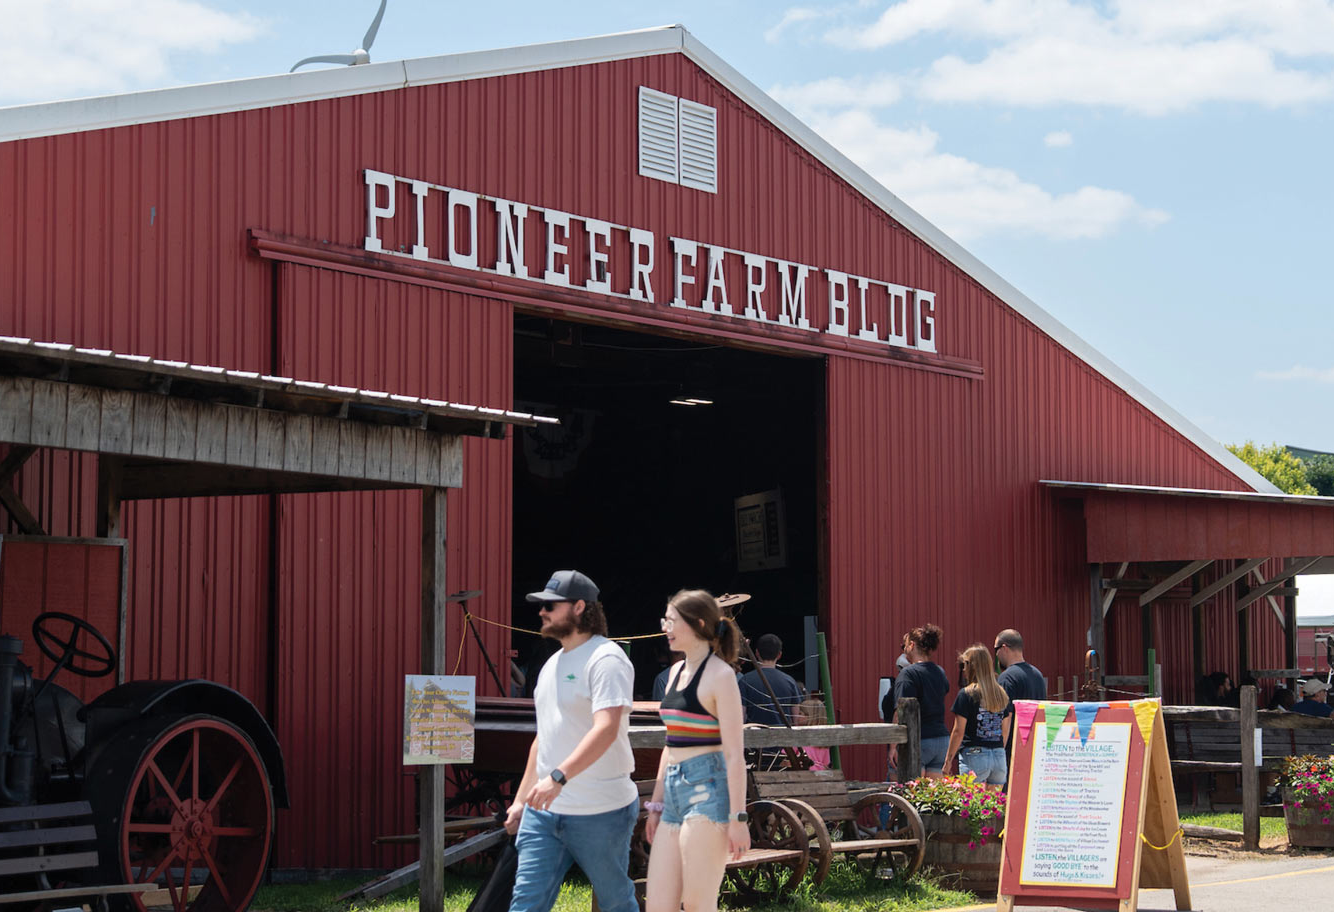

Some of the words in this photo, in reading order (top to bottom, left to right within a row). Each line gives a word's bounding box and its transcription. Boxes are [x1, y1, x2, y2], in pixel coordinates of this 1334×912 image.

[364, 169, 654, 303] PIONEER
[670, 238, 813, 331] FARM
[825, 270, 937, 354] BLDG
